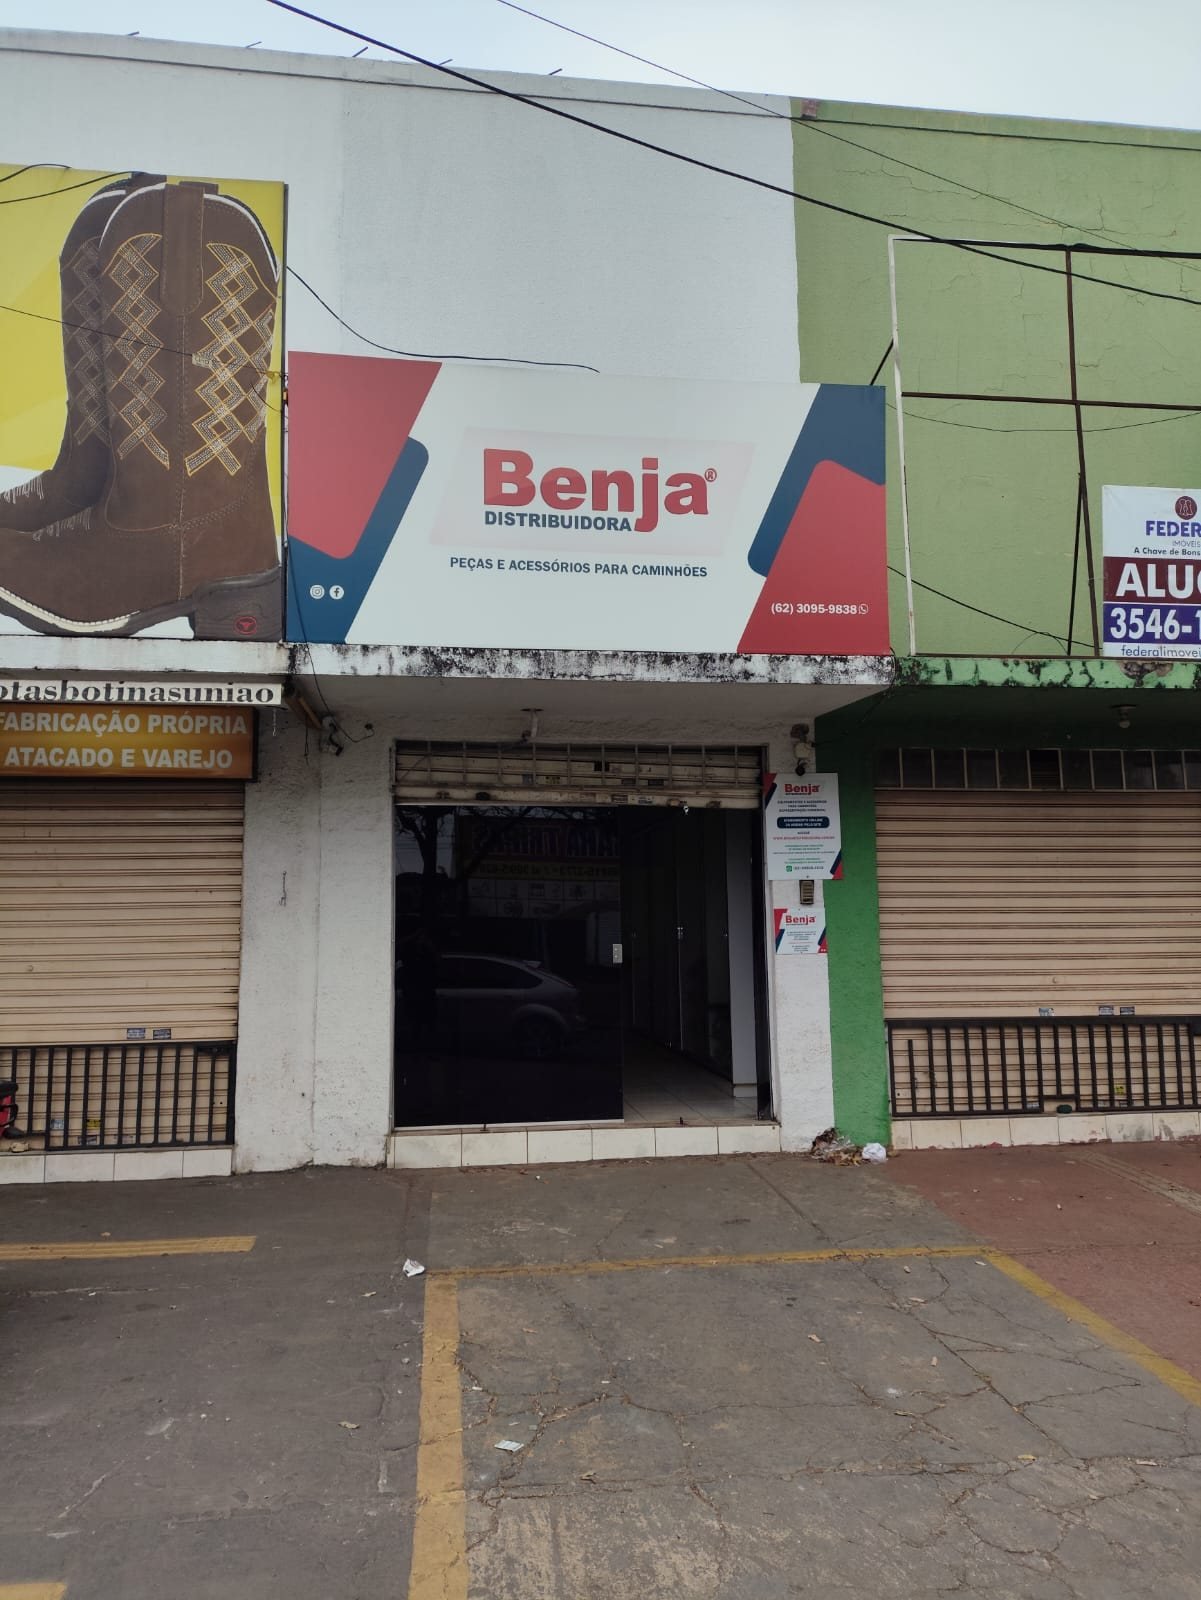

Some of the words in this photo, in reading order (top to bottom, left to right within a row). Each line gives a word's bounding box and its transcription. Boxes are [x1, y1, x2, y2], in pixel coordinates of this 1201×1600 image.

[485, 511, 632, 532] DISTRIBUIDORA
[1142, 547, 1167, 555] Chave
[1169, 548, 1180, 556] de
[1182, 548, 1201, 556] Bons
[450, 557, 493, 571] PEÇAS
[497, 559, 505, 570] E
[509, 559, 591, 574] ACESSÓRIOS
[595, 564, 629, 576] PARA
[632, 564, 708, 577] CAMINHÕES
[1115, 563, 1201, 599] ALU
[771, 603, 794, 615] (62)
[796, 603, 857, 615] 3095-9838
[147, 711, 247, 734] PRÓPRIA
[4, 747, 114, 768] ATACADO
[121, 748, 135, 767] E
[142, 748, 233, 769] VAREJO
